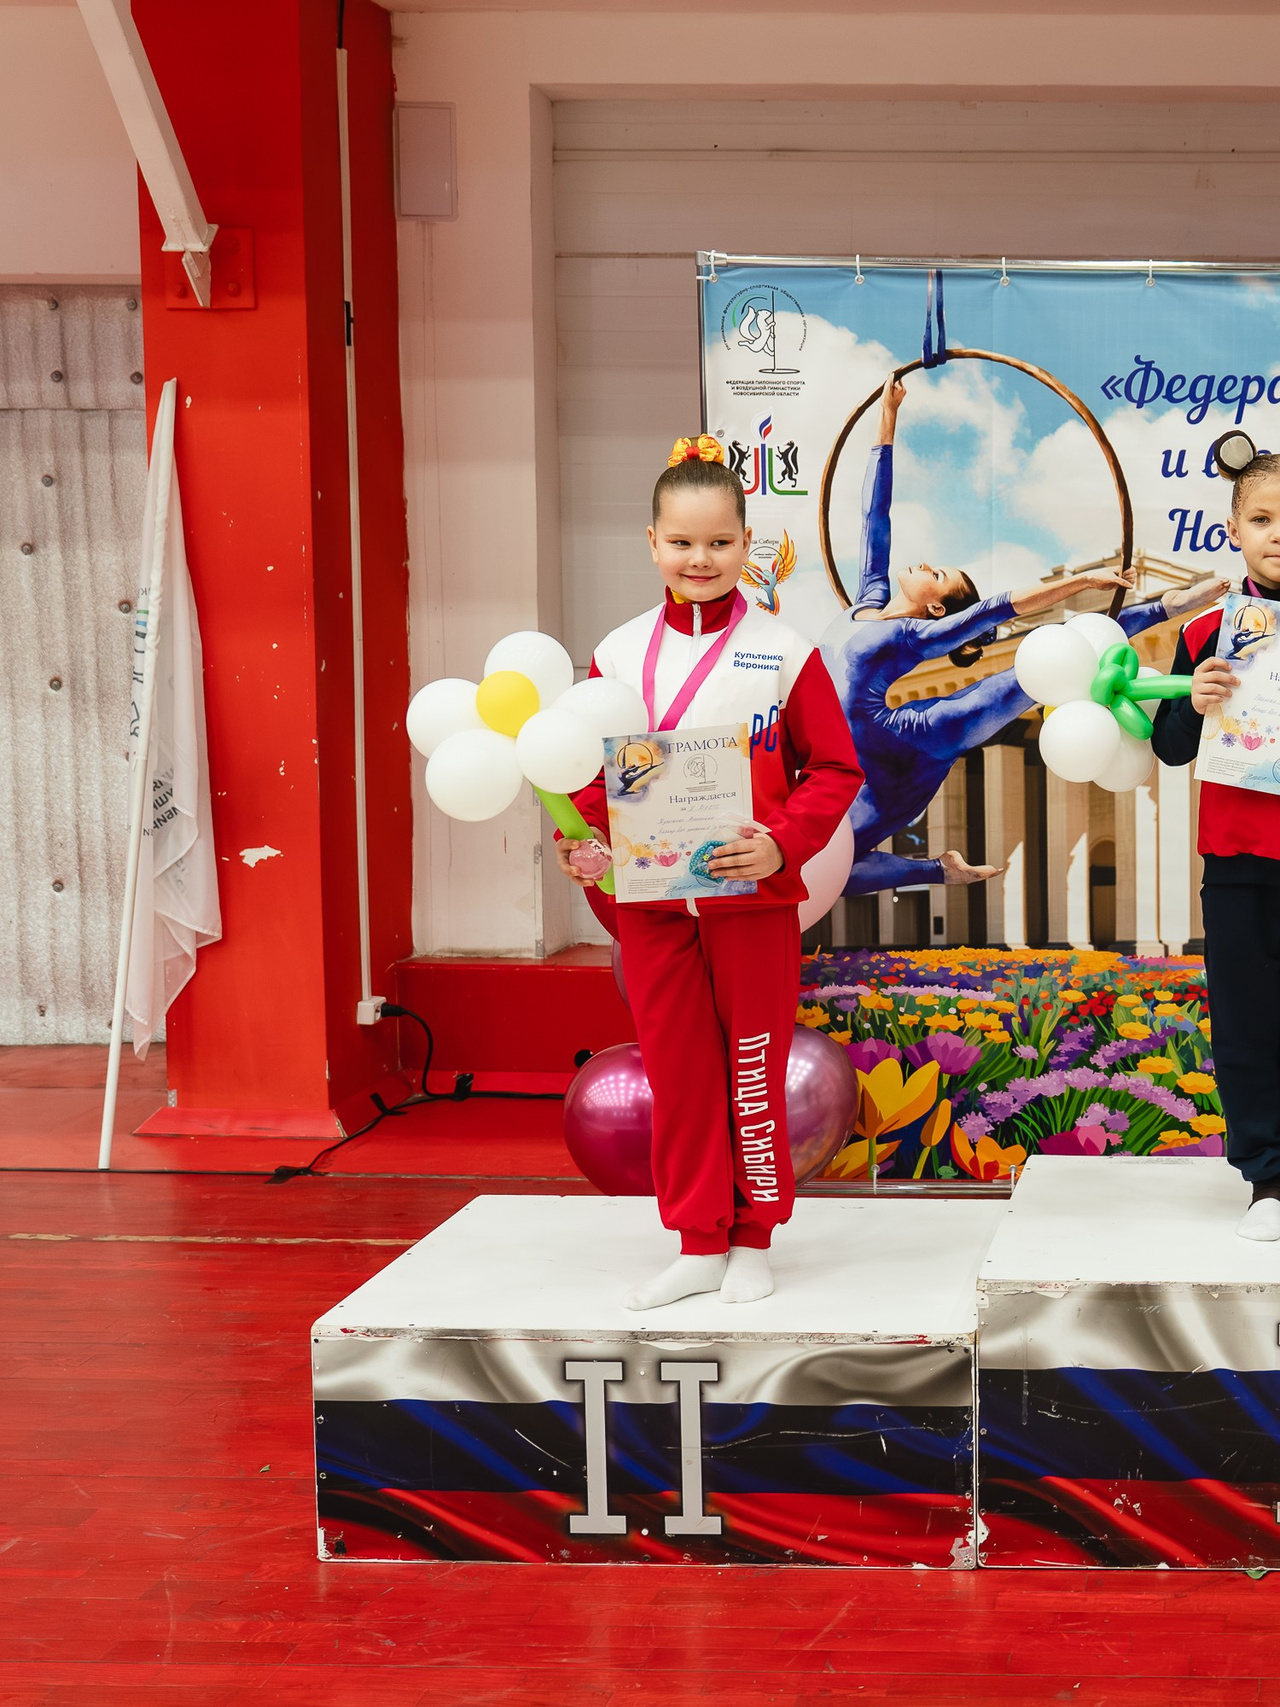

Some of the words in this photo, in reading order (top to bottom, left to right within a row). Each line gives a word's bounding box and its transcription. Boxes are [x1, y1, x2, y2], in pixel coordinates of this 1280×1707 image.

[1161, 448, 1188, 478] и
[733, 660, 780, 671] Вероника
[734, 651, 784, 661] Культенко
[667, 736, 738, 754] ГРАМОТА
[669, 791, 737, 805] Награждается
[734, 1032, 771, 1117] ПТИЦА
[740, 1119, 780, 1203] СИБИРИ
[565, 1361, 723, 1535] II
